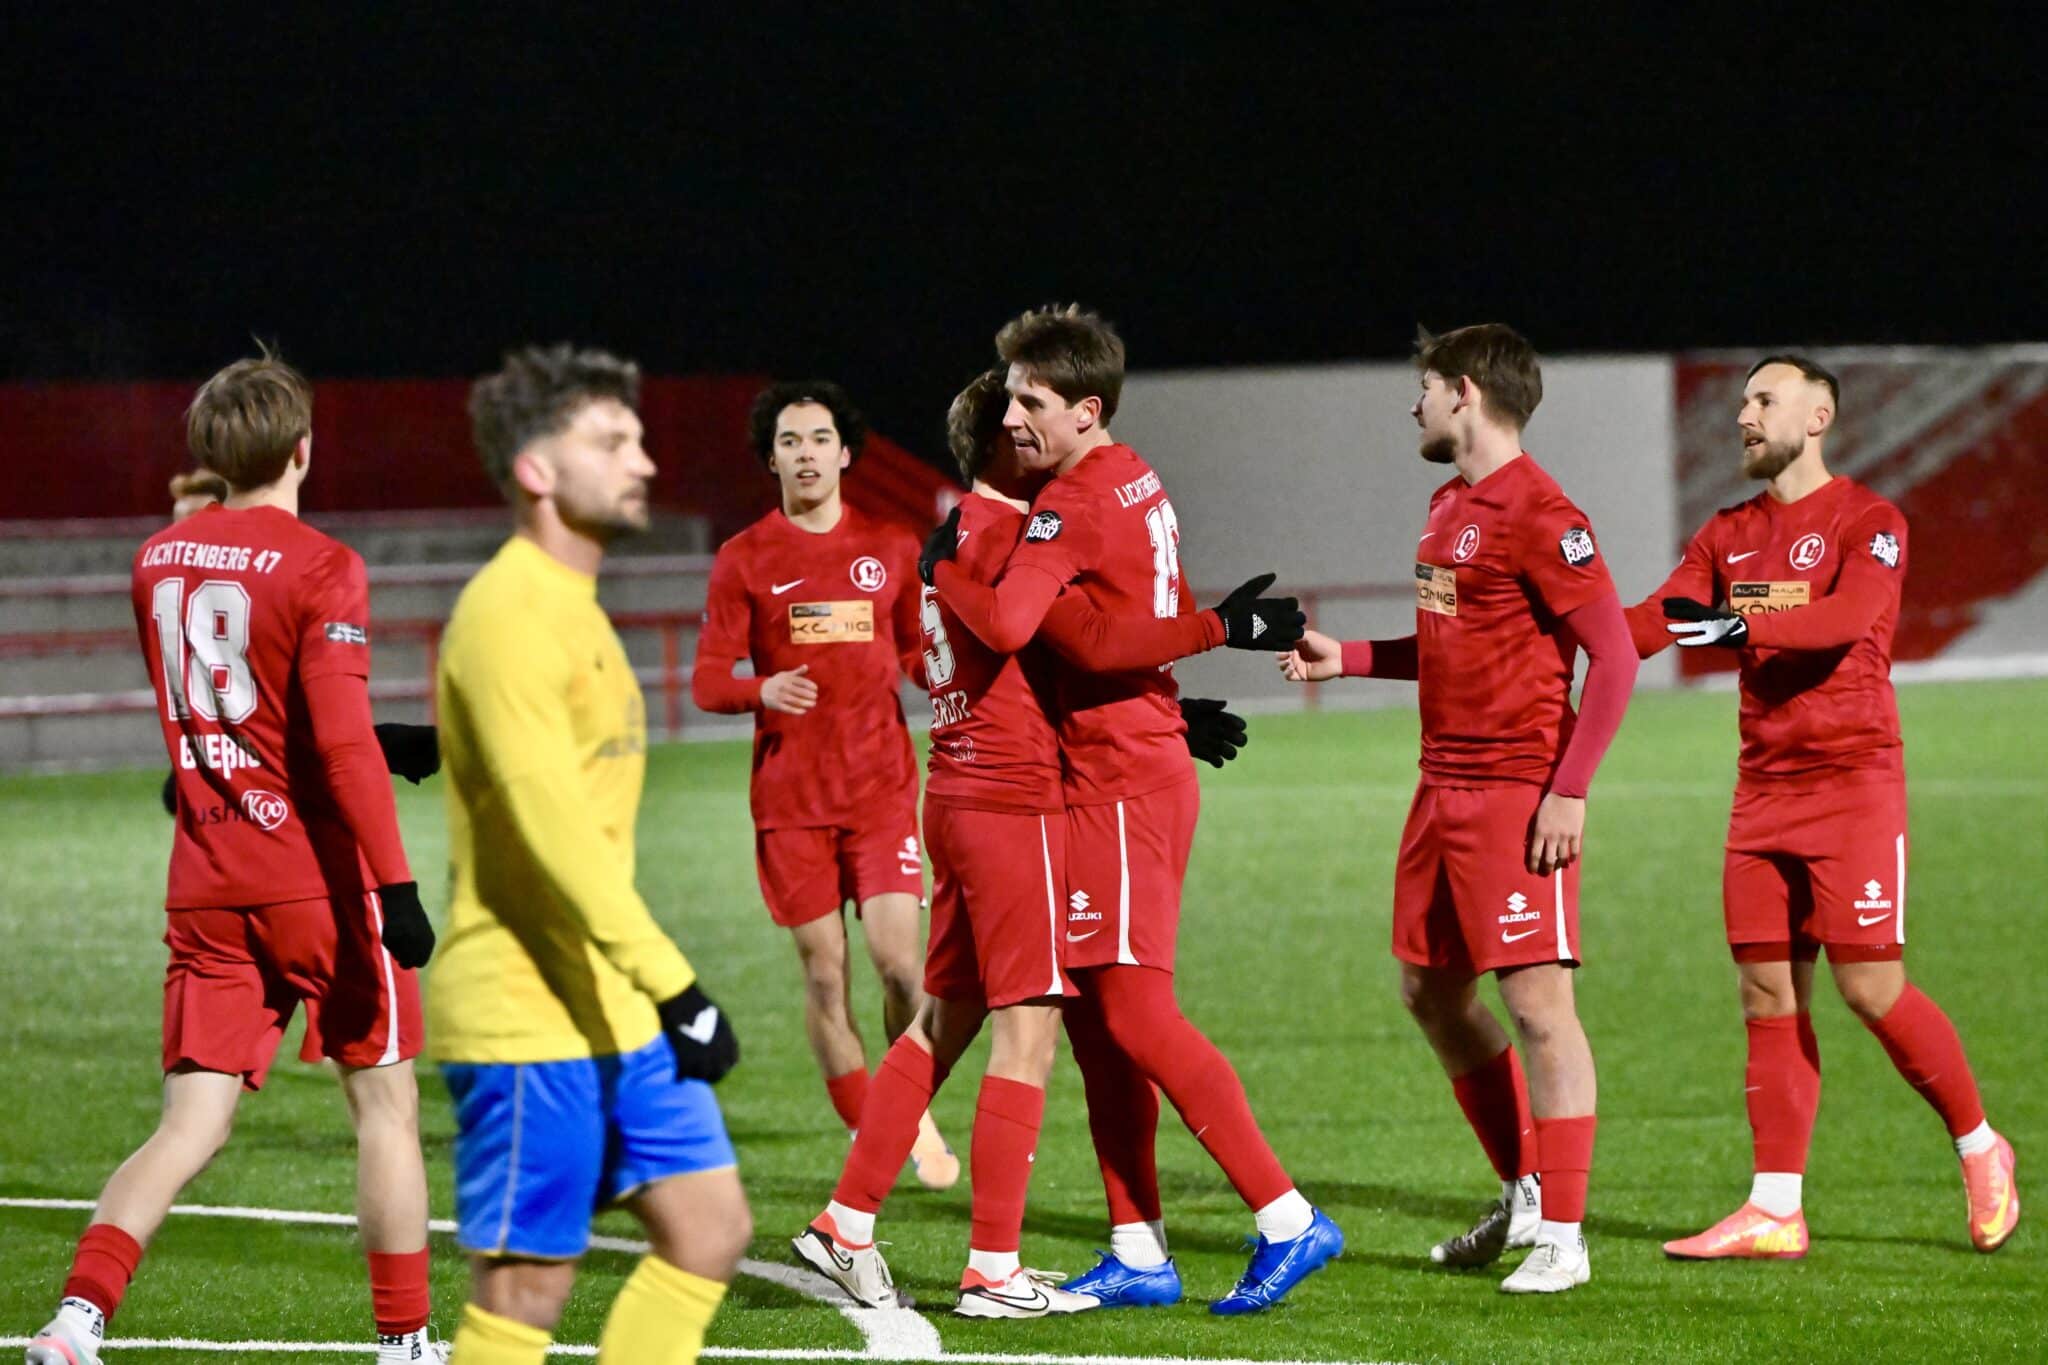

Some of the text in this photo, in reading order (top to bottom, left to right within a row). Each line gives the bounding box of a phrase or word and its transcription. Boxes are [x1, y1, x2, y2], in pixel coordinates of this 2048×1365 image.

[142, 541, 282, 574] LICHTENBERG 47
[1417, 583, 1456, 606] ÖNIG
[1735, 587, 1768, 595] AUTO
[1731, 600, 1801, 616] KÖNI
[152, 577, 258, 725] 18
[1068, 911, 1103, 922] UZUKI
[1752, 1221, 1802, 1252] NIKE
